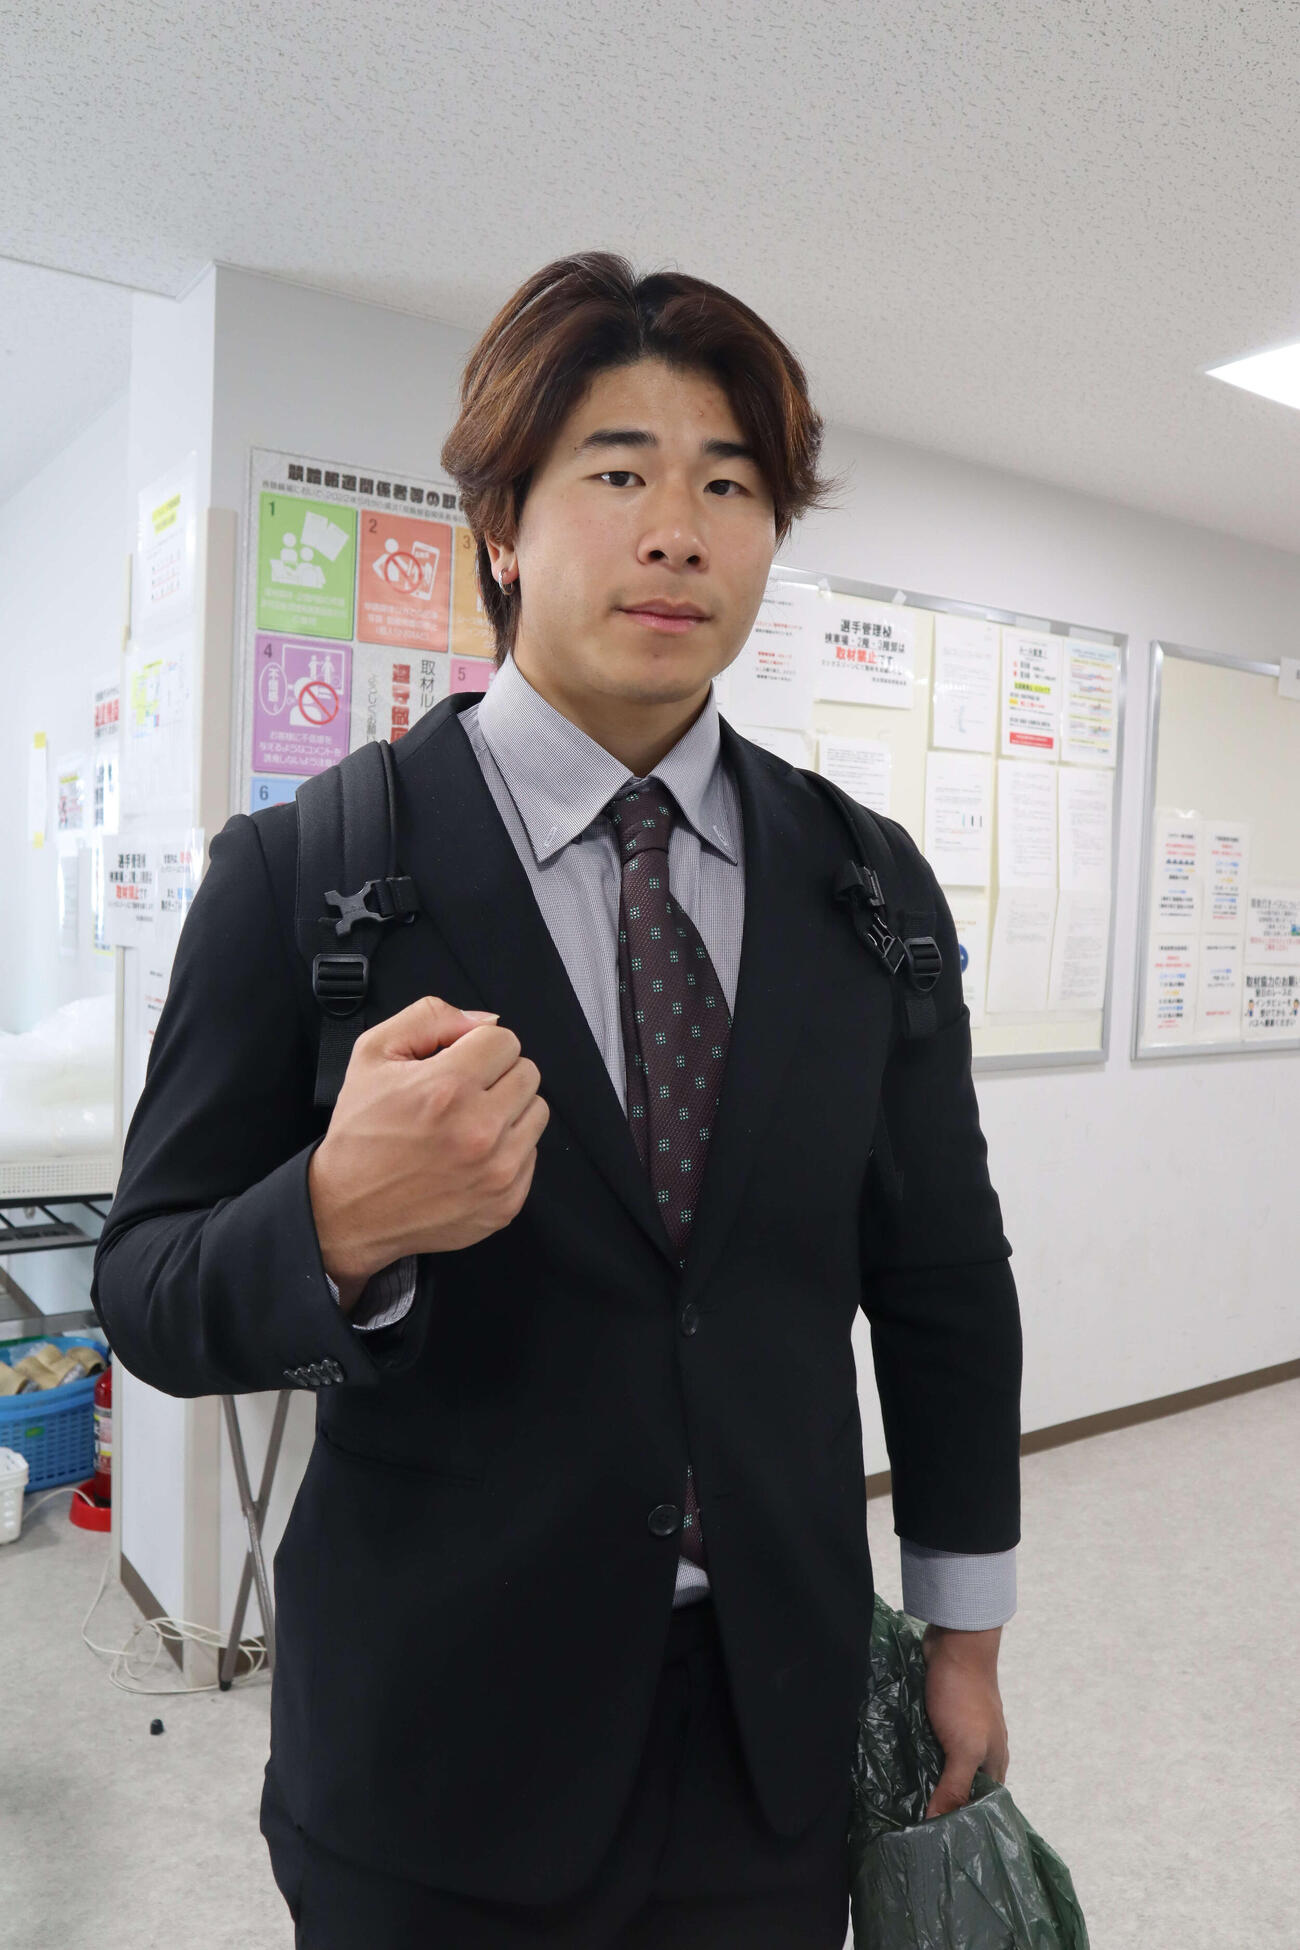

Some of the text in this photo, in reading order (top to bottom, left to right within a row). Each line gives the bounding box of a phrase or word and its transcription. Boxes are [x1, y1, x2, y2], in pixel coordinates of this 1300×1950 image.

[288, 463, 465, 511] 競輪報道関係者等の取
[269, 501, 276, 516] 1
[369, 518, 378, 532] 2
[463, 535, 471, 549] 3
[264, 643, 273, 658] 4
[457, 667, 466, 681] 5
[420, 659, 436, 711] 取材ル
[259, 785, 269, 800] 6
